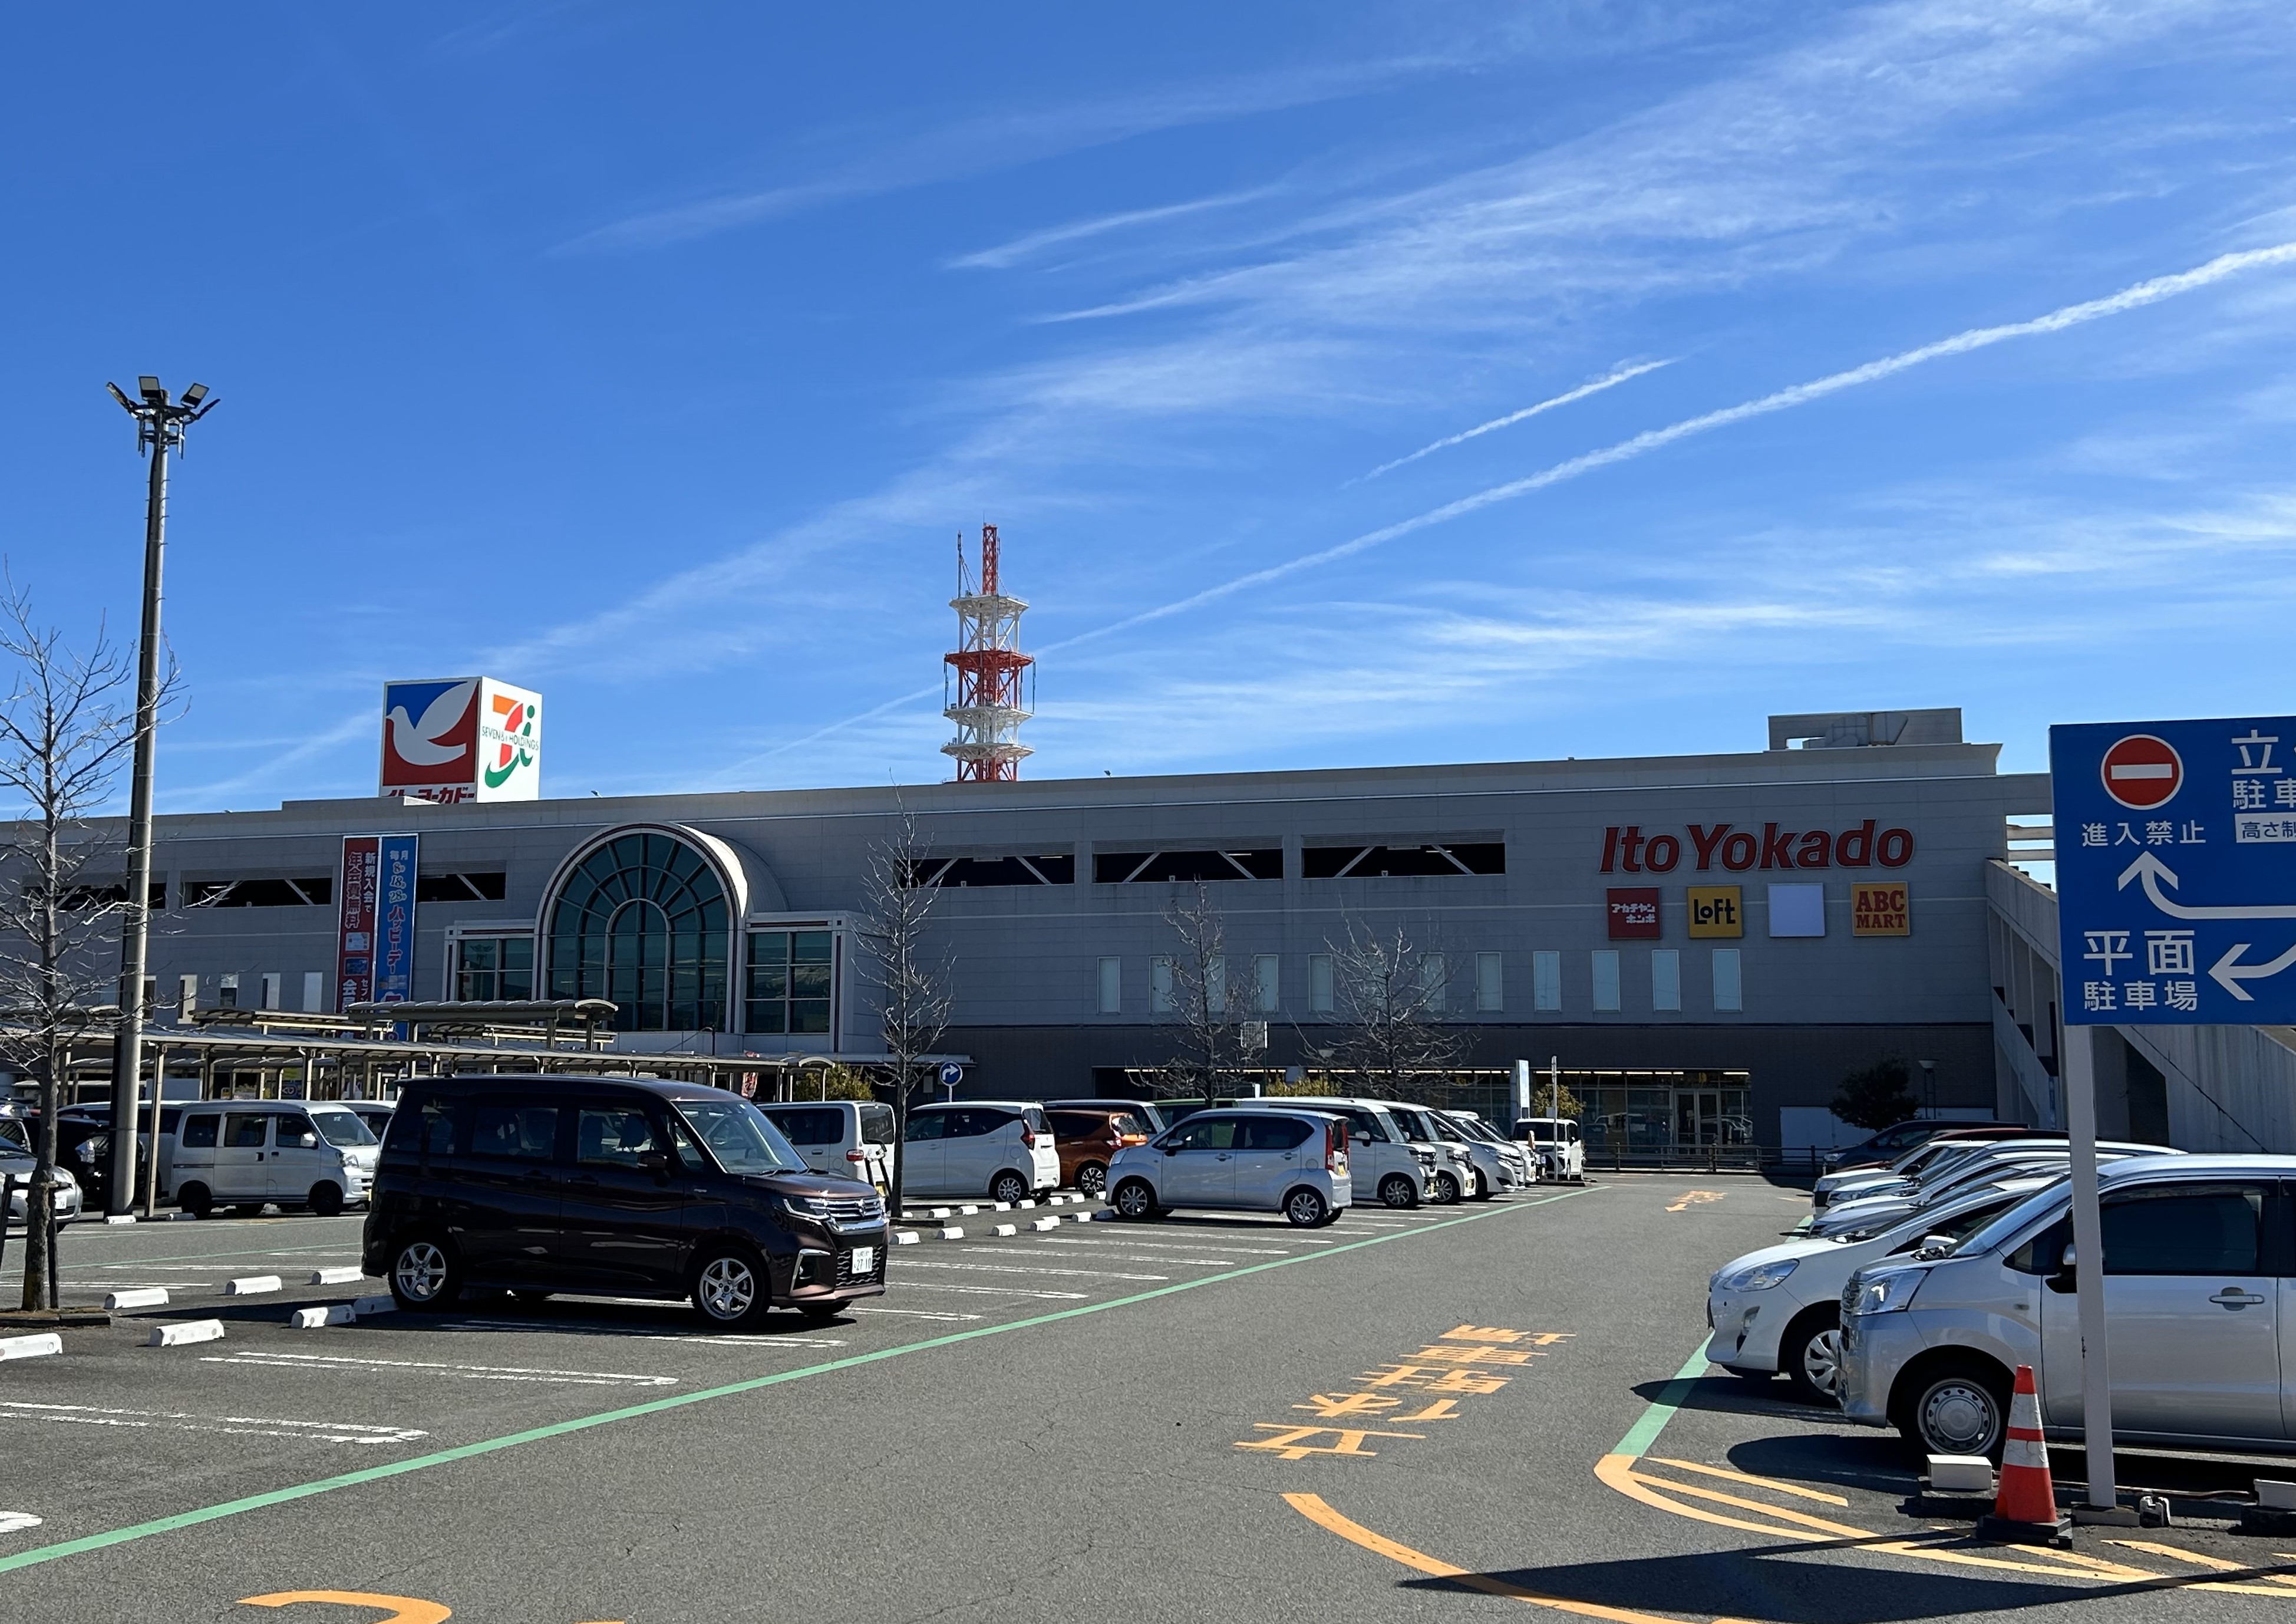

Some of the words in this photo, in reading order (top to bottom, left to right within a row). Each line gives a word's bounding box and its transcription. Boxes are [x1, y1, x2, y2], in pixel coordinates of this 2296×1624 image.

[509, 734, 539, 751] HOLDINGS
[2231, 729, 2296, 775] 立
[1599, 825, 1680, 874] Ito
[1685, 818, 1914, 872] Yokado
[2082, 820, 2206, 846] 進入禁止
[363, 852, 376, 913] 新規入会で
[1856, 890, 1905, 913] ABC
[1856, 914, 1906, 928] MART
[2084, 930, 2195, 976] 平面
[2084, 980, 2198, 1011] 駐車場
